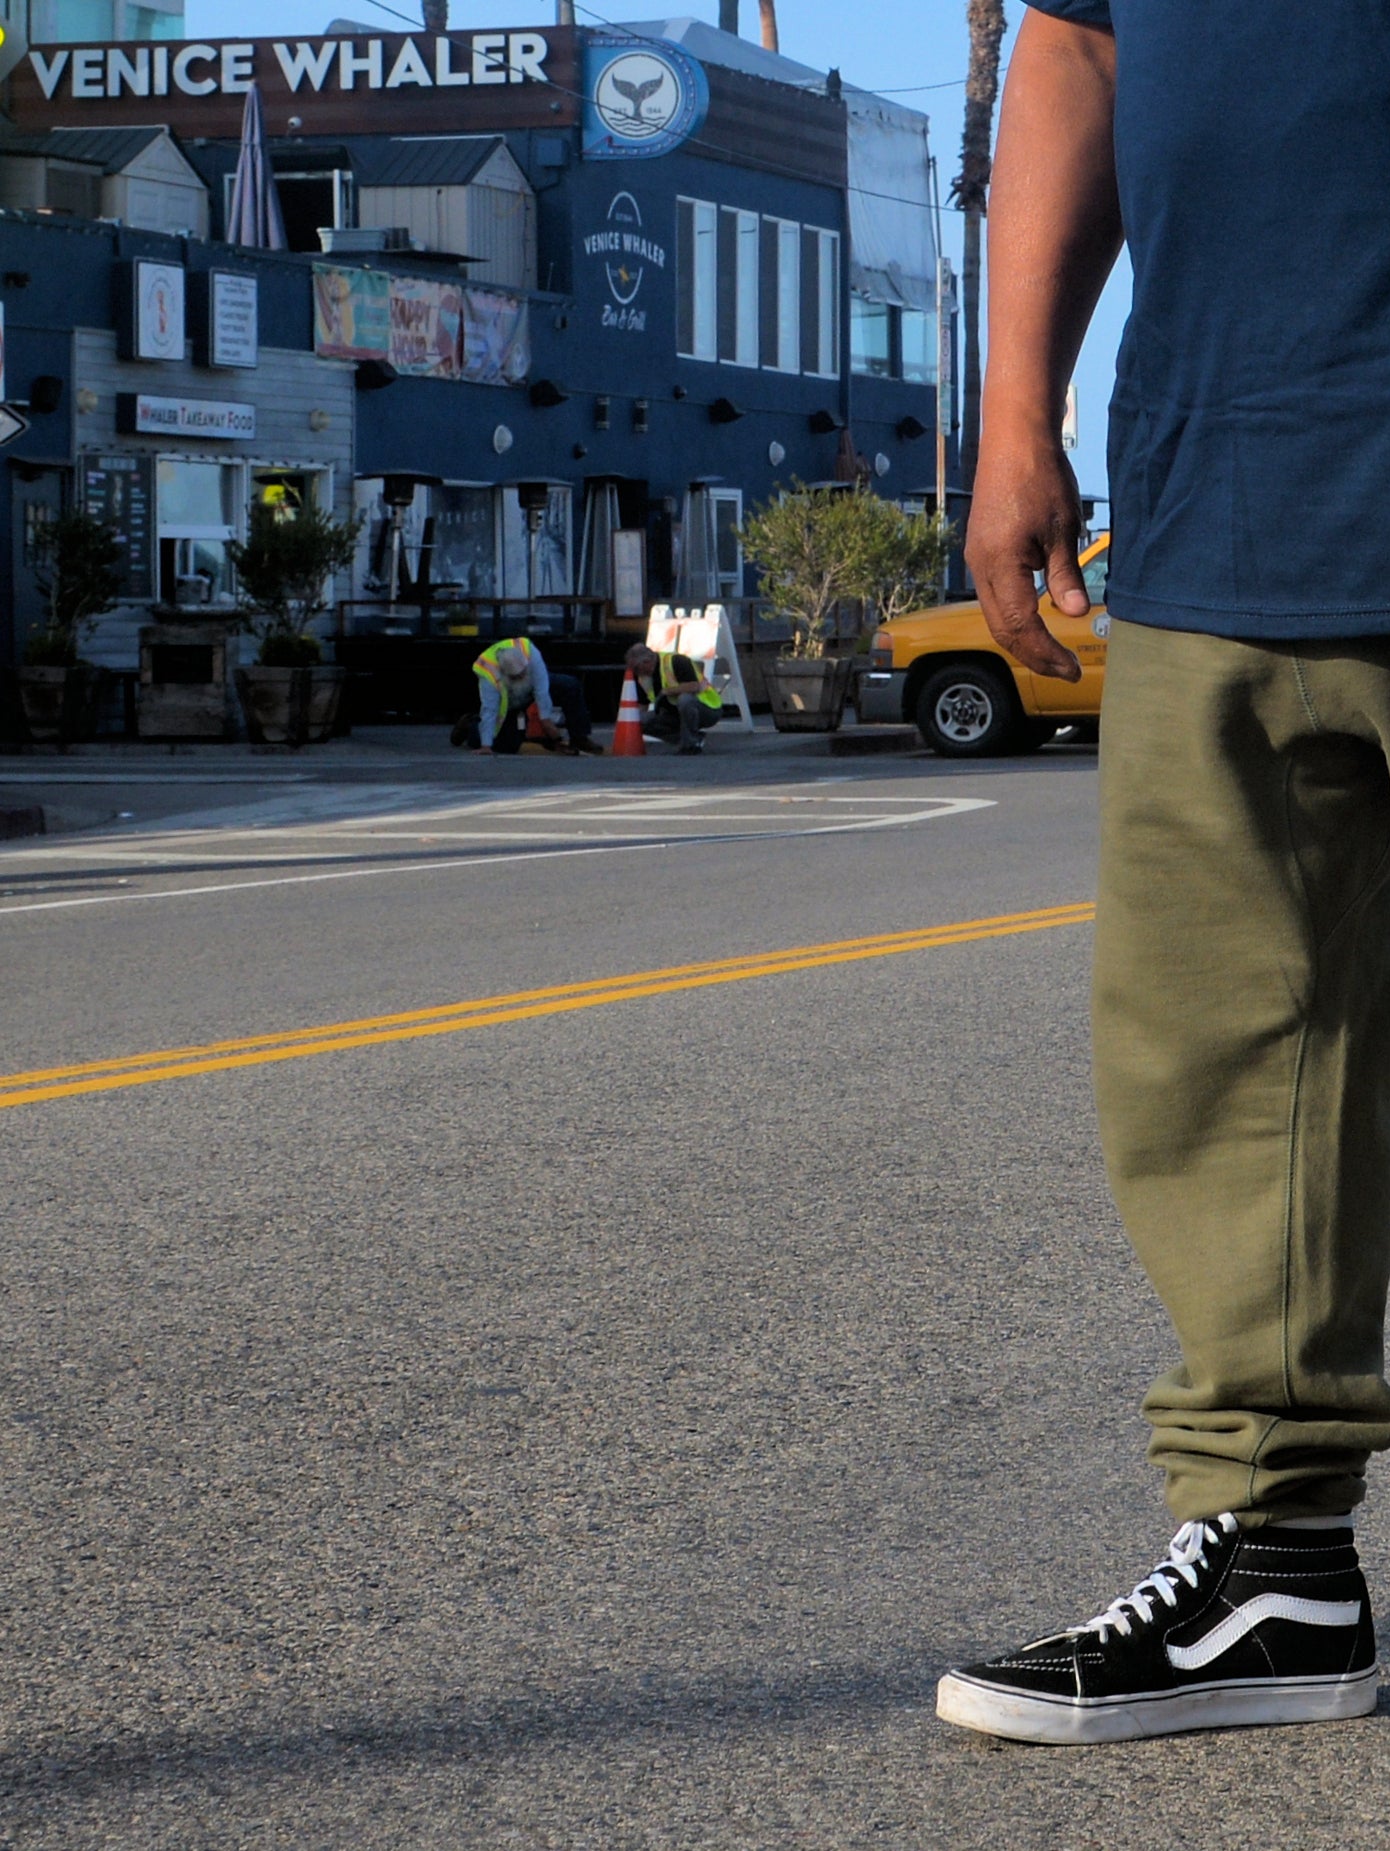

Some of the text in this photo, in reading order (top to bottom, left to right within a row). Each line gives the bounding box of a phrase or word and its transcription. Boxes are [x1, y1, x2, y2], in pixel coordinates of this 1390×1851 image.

[28, 32, 549, 100] VENICE WHALER
[584, 232, 664, 268] VENICE WHALER
[227, 410, 252, 430] FOOD
